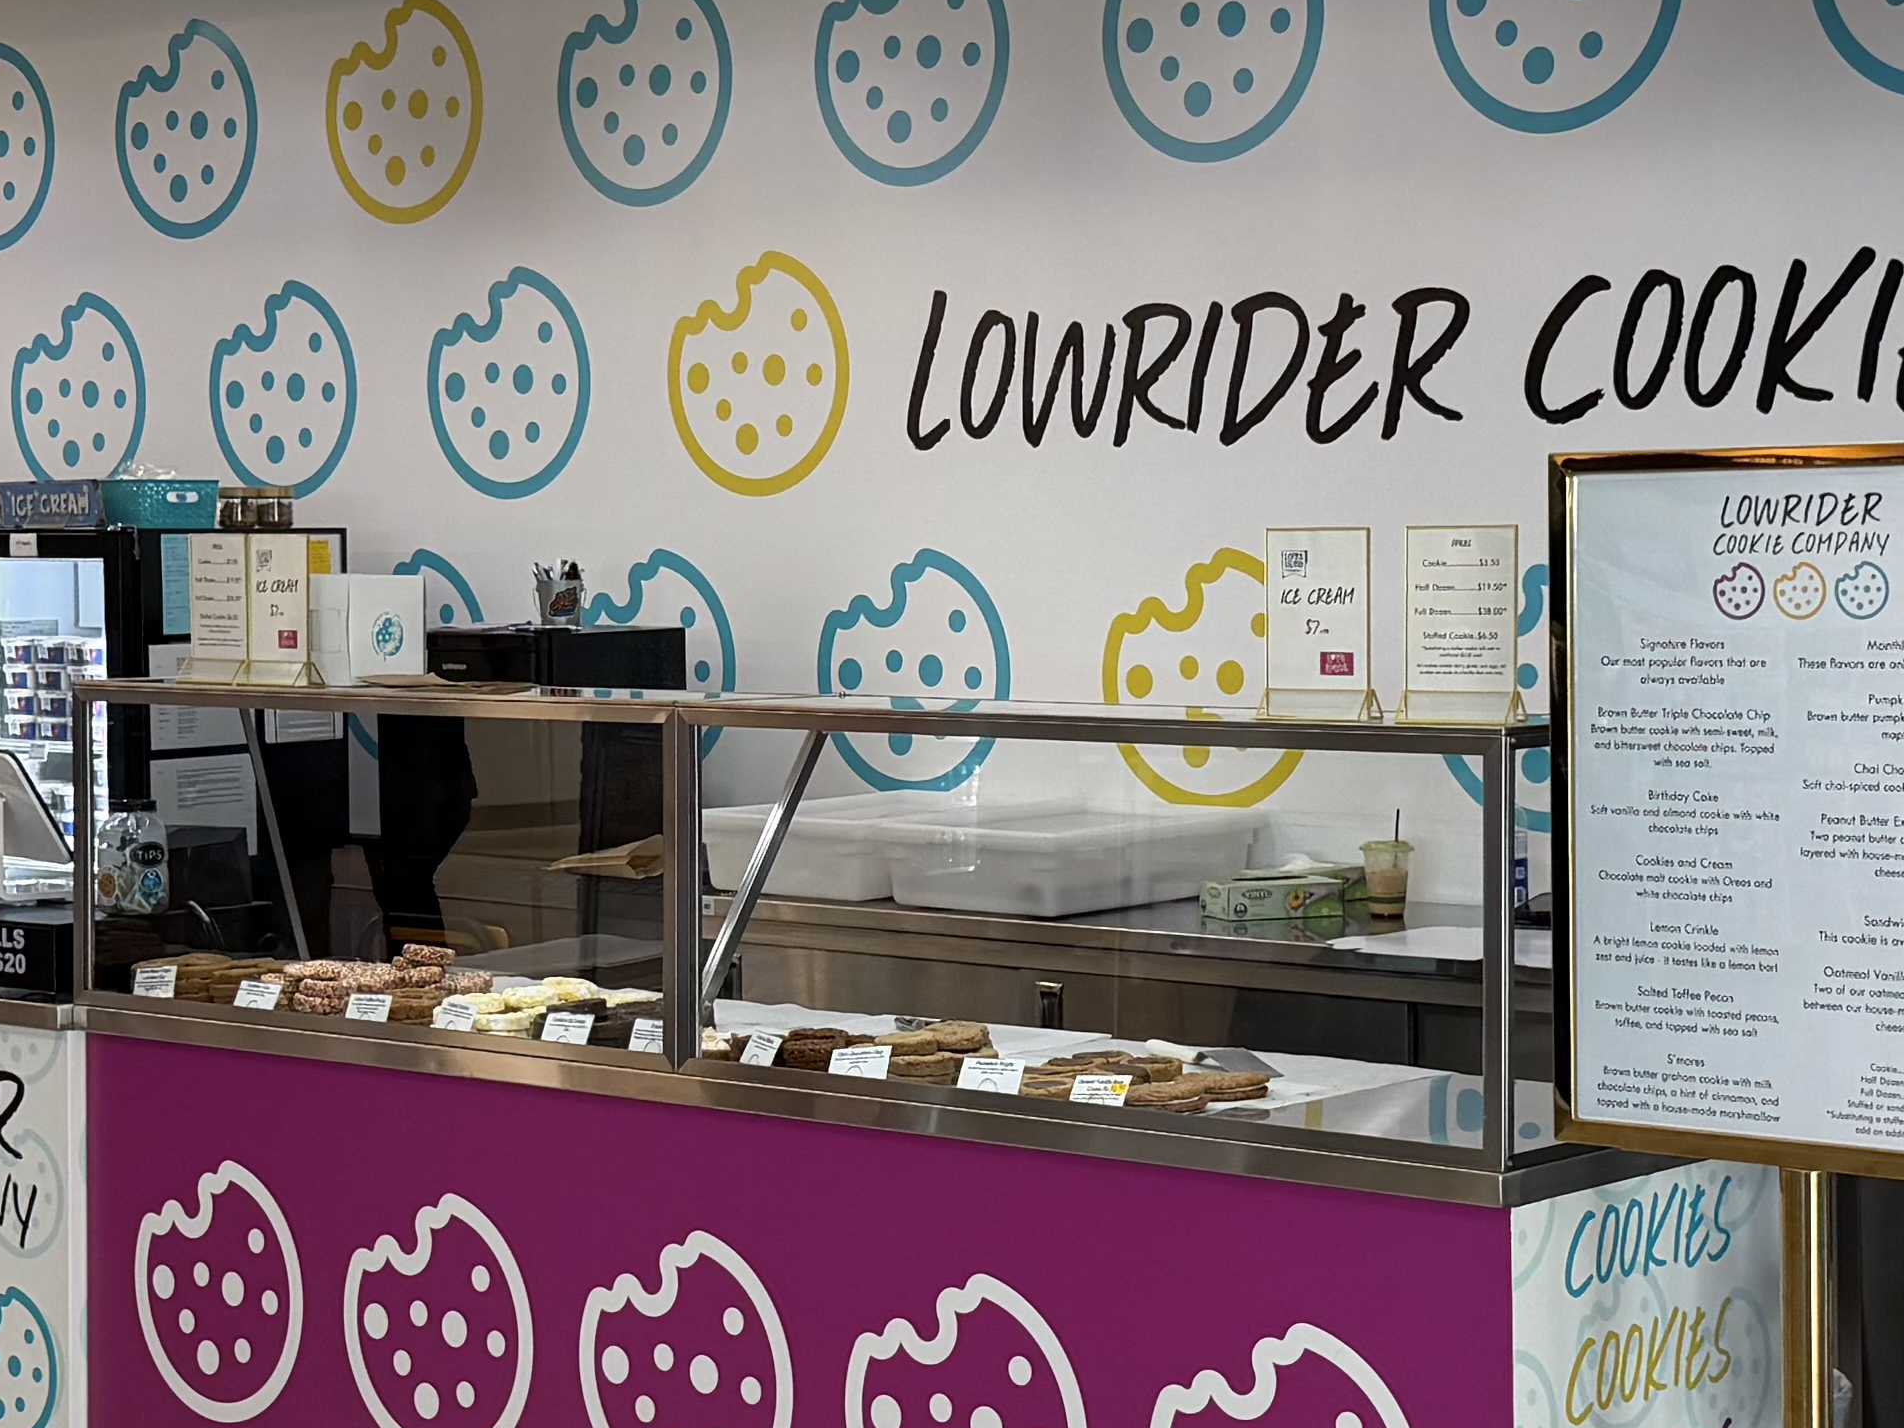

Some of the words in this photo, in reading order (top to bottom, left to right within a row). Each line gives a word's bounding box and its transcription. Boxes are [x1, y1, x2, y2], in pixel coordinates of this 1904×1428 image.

[905, 287, 1472, 451] LOWRIDER
[11, 494, 35, 517] ICE
[40, 492, 89, 515] CREAM
[1720, 492, 1883, 528] LOWRIDER
[1713, 533, 1784, 555] COOKIE
[1791, 530, 1890, 556] COMPANY
[1280, 589, 1301, 605] ICE
[1307, 587, 1355, 604] CREAM
[1640, 638, 1686, 651] Signature
[1690, 638, 1725, 649] Flavors
[1798, 658, 1827, 669] These
[1830, 658, 1864, 669] flavors
[1868, 661, 1885, 669] are
[1598, 707, 1627, 718] Brown
[1631, 708, 1658, 718] Butter
[1662, 708, 1688, 721] Triple
[1692, 709, 1743, 719] Chocolate
[1747, 709, 1771, 722] Chip
[1854, 763, 1879, 774] Chai
[1648, 790, 1689, 803] Birthday
[1693, 791, 1719, 802] Cake
[1821, 813, 1856, 825] Peanut
[1859, 815, 1889, 826] Butter
[138, 850, 162, 860] TIPS
[1635, 855, 1674, 867] Cookies
[1678, 858, 1696, 868] and
[1700, 858, 1733, 869] Cream
[1650, 922, 1681, 934] Lemon
[1685, 924, 1719, 936] Crinkle
[1819, 931, 1838, 942] This
[1842, 934, 1877, 945] cookie
[1880, 936, 1888, 945] is
[1824, 966, 1870, 979] Oatmeal
[1638, 986, 1668, 997] Salted
[1672, 988, 1701, 1000] Toffee
[1704, 991, 1734, 1003] Pecan
[1667, 1054, 1705, 1067] S'mores
[1564, 1175, 1734, 1299] COOKIES
[1564, 1296, 1734, 1427] COOKIES
